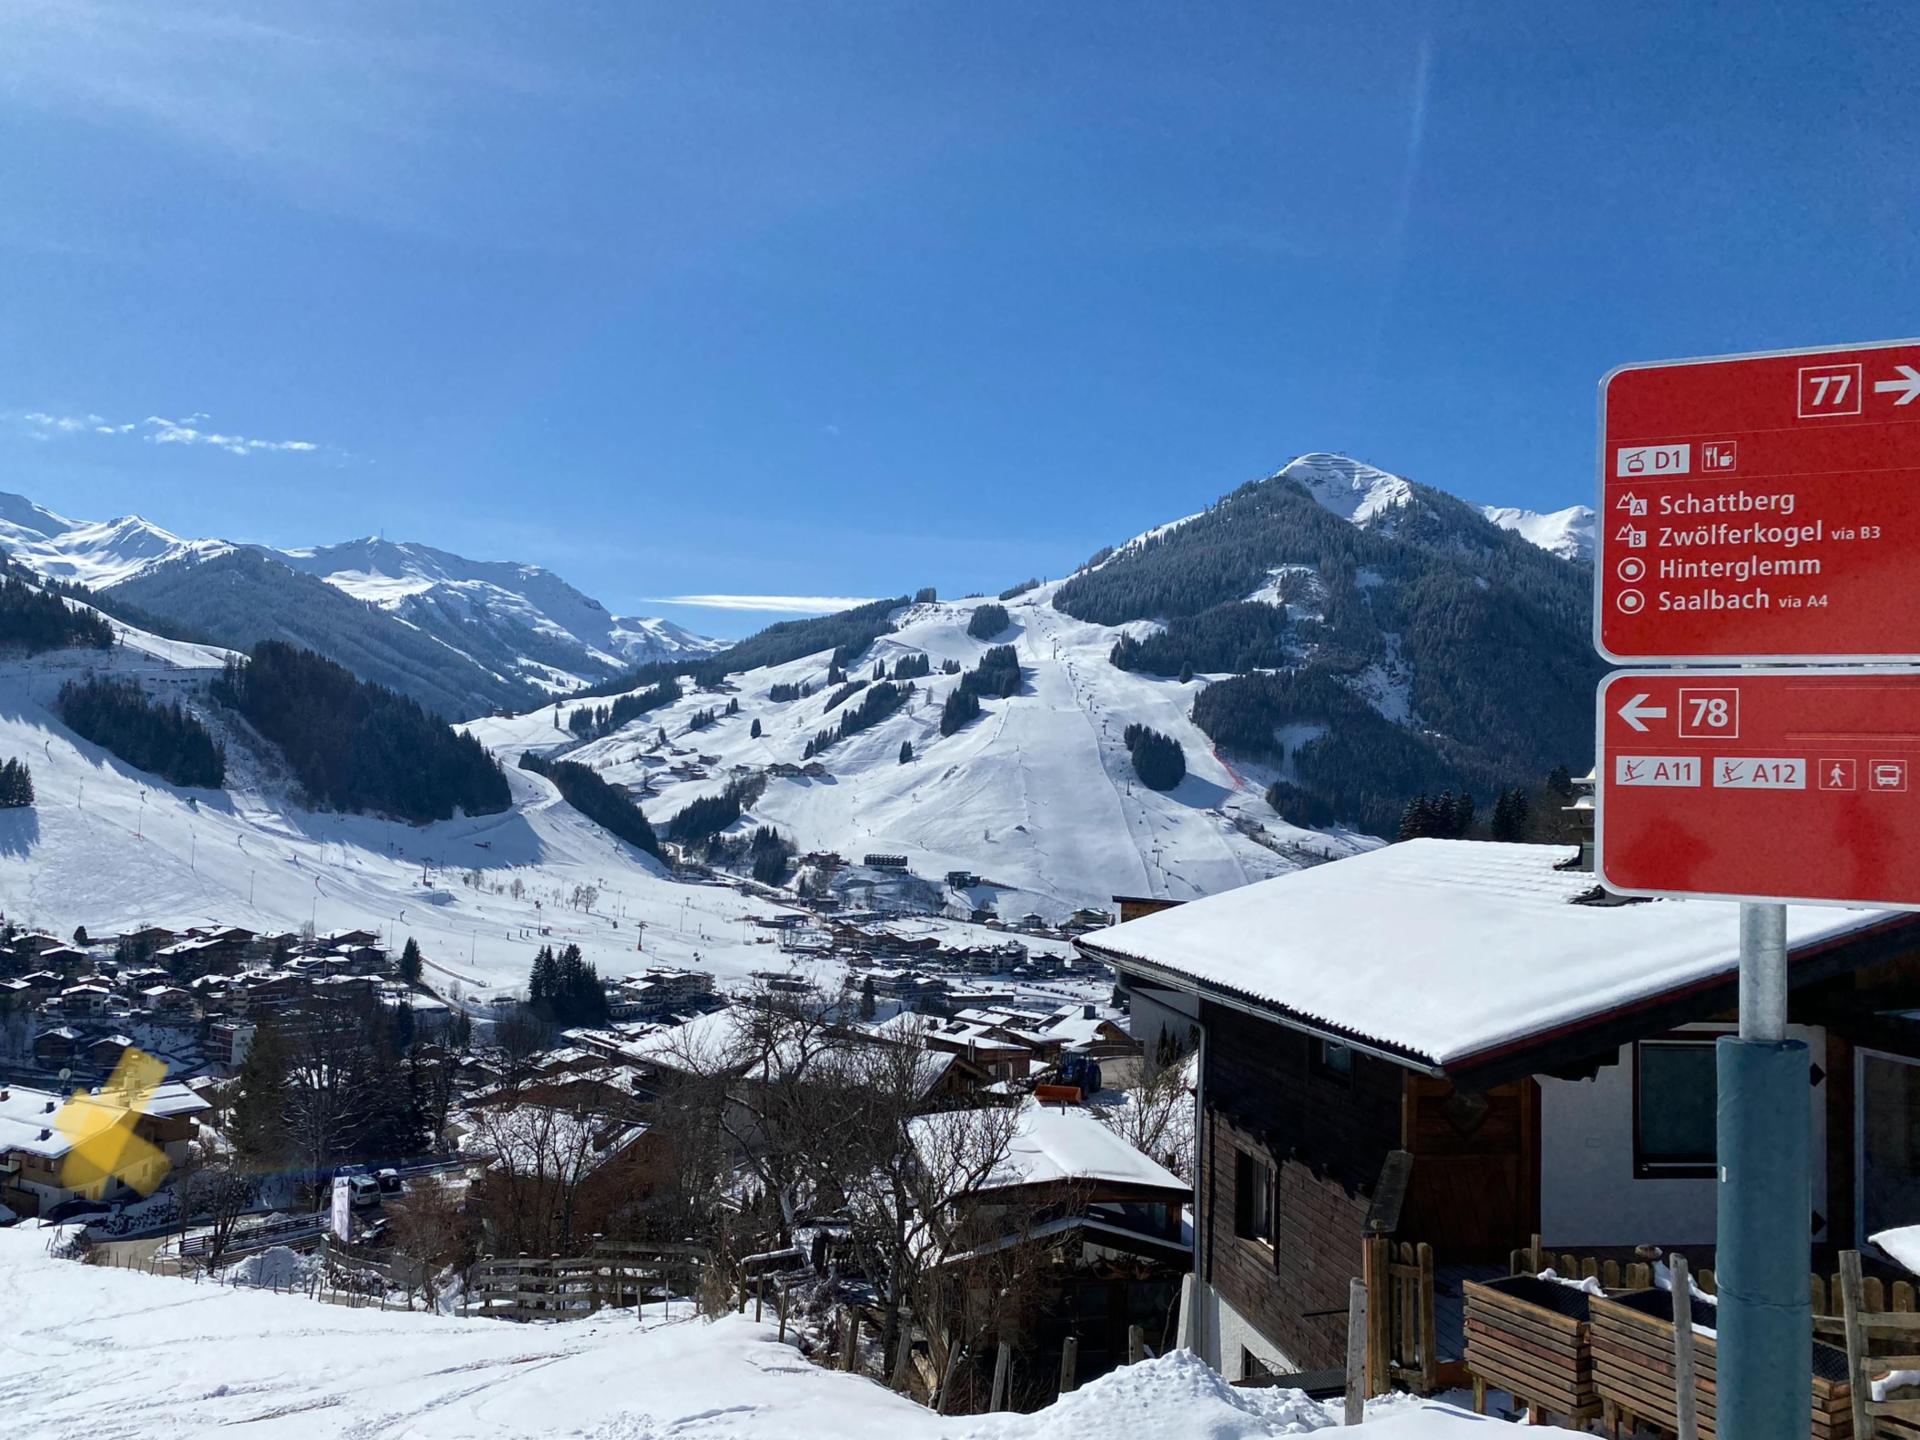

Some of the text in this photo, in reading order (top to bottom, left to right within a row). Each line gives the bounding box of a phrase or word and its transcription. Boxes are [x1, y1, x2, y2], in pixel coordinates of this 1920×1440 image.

[1810, 374, 1851, 406] 77
[1655, 450, 1681, 469] D1
[1633, 491, 1795, 515] A Schattberg
[1633, 520, 1881, 548] B Zwölferkogel via B3
[1659, 555, 1821, 582] Hinterglemm
[1659, 588, 1828, 611] Saalbach via A4
[1689, 698, 1728, 727] 78
[1654, 762, 1691, 781] A11
[1752, 763, 1796, 783] A12
